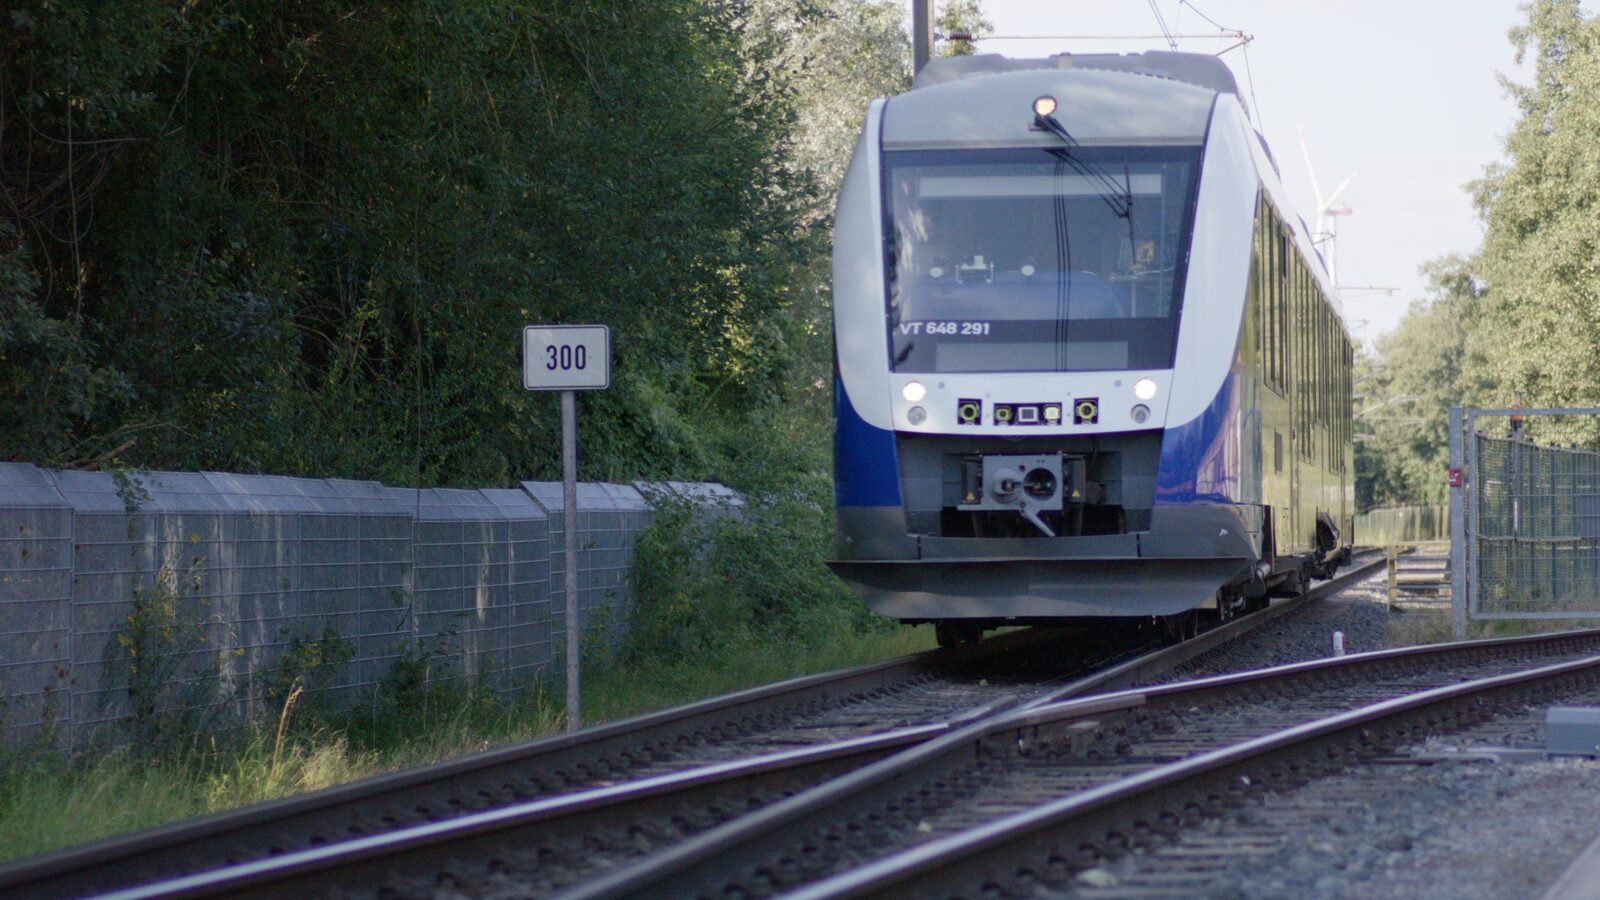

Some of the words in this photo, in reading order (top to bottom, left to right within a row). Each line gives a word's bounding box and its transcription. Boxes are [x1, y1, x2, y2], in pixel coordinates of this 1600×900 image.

[900, 322, 923, 335] VT
[925, 322, 957, 334] 648
[961, 322, 990, 335] 291
[546, 344, 586, 370] 300
